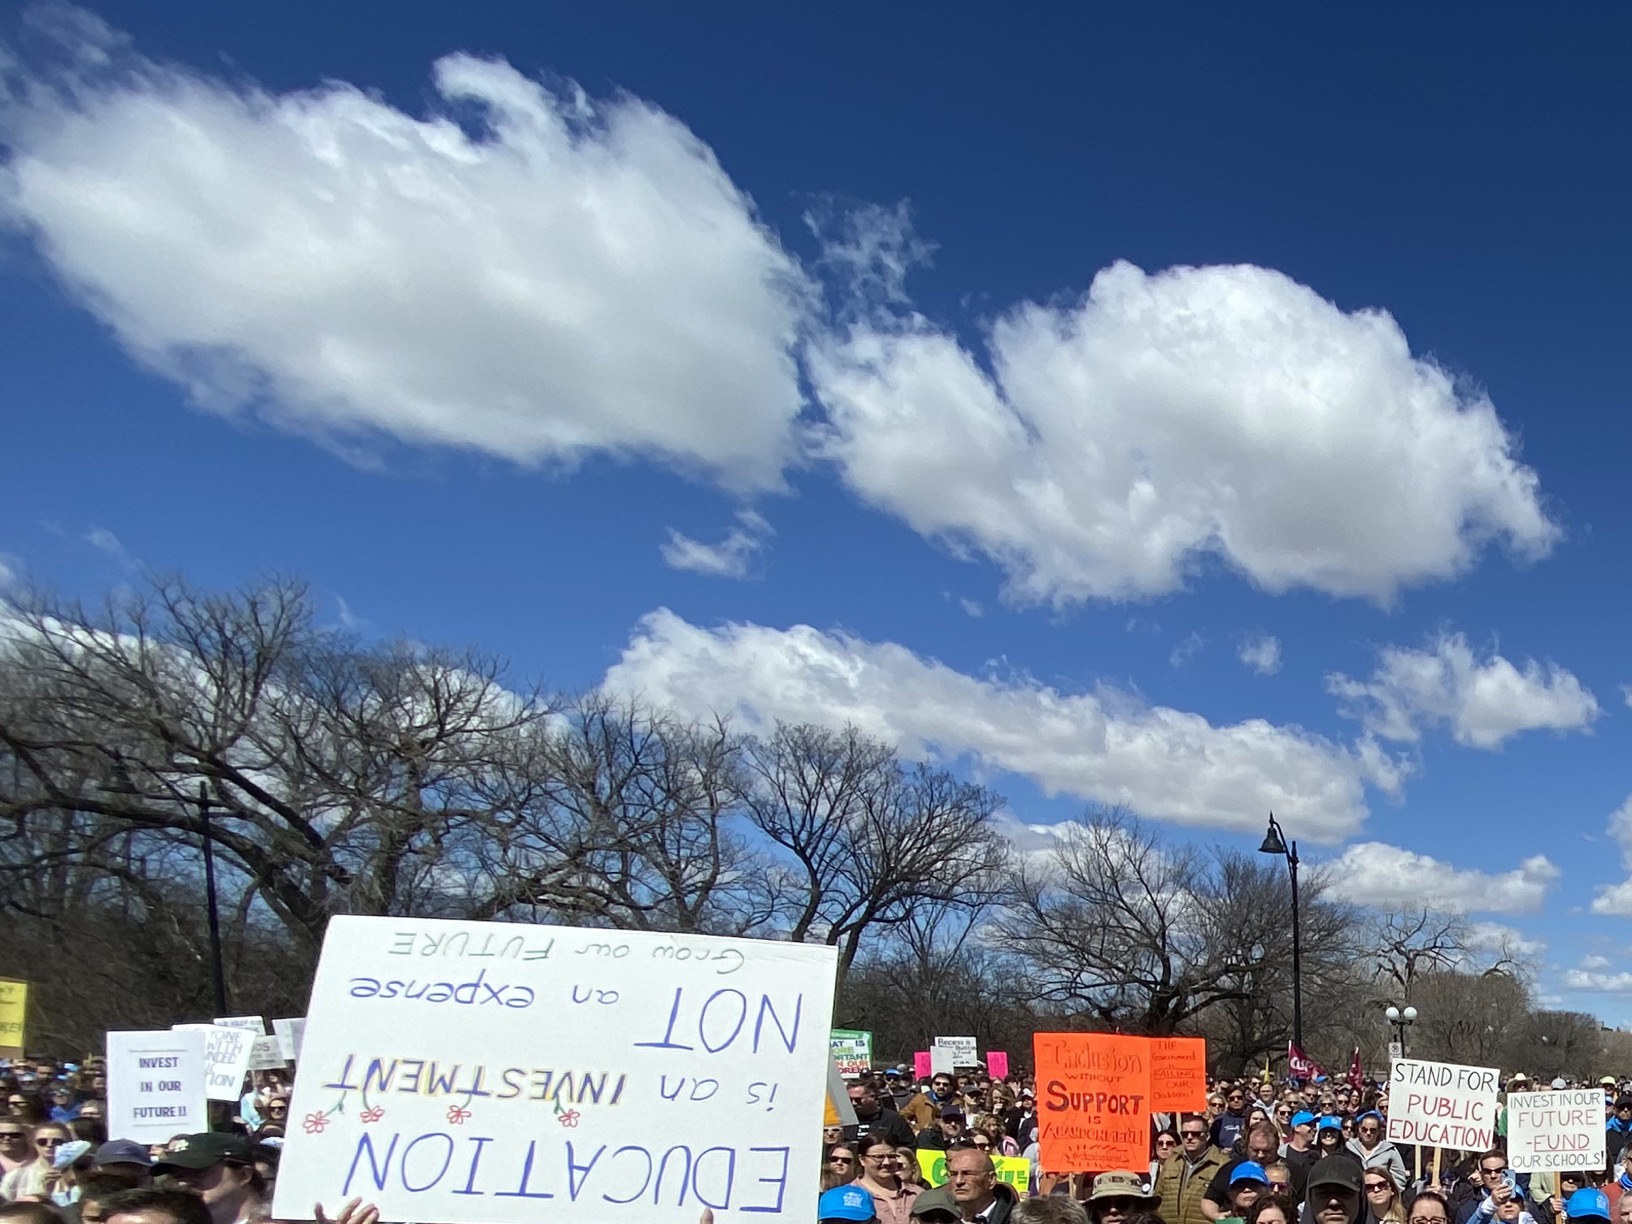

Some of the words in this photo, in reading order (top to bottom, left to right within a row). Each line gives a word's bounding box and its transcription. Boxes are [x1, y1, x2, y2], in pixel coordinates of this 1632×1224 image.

[388, 932, 553, 961] FUTURE
[576, 943, 630, 960] our
[653, 944, 745, 975] Grow
[349, 968, 535, 1008] expense
[573, 985, 619, 1005] an
[634, 987, 804, 1054] NOT
[139, 1057, 179, 1069] INVEST
[140, 1081, 153, 1092] IN
[158, 1081, 182, 1092] OUR
[324, 1054, 629, 1106] INVESTMENT
[661, 1077, 719, 1101] an
[1064, 1073, 1125, 1083] WITHOUT
[1395, 1063, 1452, 1086] STAND
[1459, 1070, 1494, 1093] FOR
[747, 1082, 779, 1112] is
[1045, 1080, 1144, 1115] SUPPORT
[1407, 1094, 1484, 1122] PUBLIC
[1510, 1094, 1556, 1110] INVEST
[1560, 1094, 1573, 1106] IN
[1574, 1092, 1600, 1105] OUR
[1088, 1115, 1101, 1125] IS
[1519, 1108, 1598, 1128] FUTURE
[1389, 1119, 1491, 1149] EDUCATION
[342, 1132, 790, 1214] EDUCATION
[1511, 1155, 1541, 1168] OUR
[1545, 1150, 1605, 1167] SCHOOLS!
